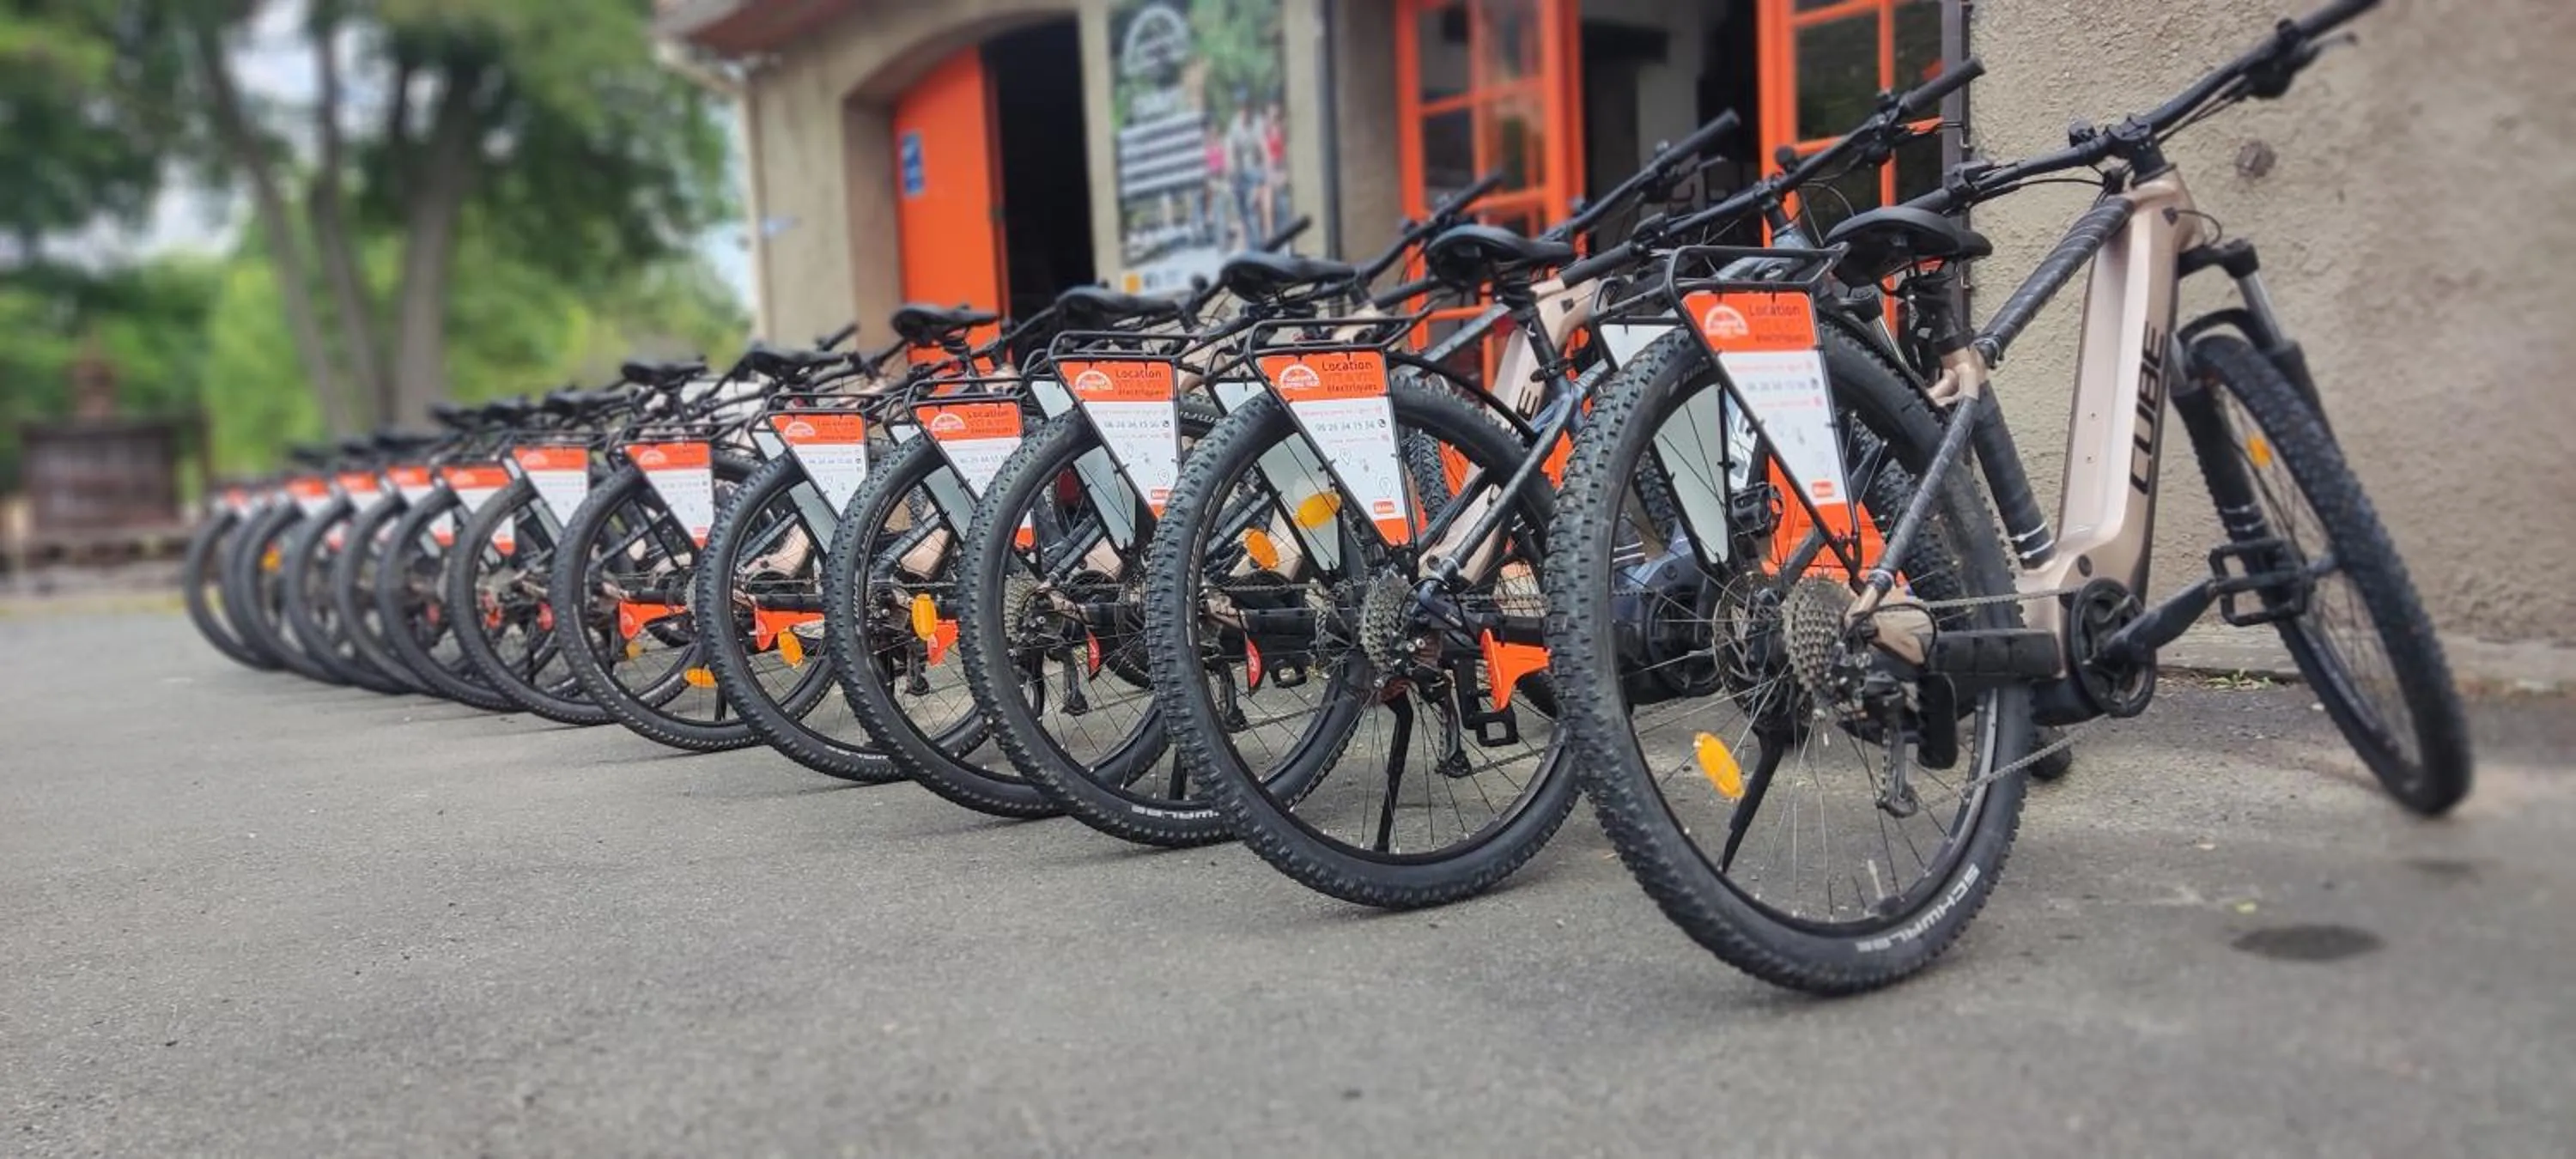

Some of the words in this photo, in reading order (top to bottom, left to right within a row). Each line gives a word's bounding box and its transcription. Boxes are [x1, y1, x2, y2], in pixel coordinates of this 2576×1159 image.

[1748, 304, 1801, 317] Location
[1321, 361, 1373, 372] Location
[1115, 368, 1162, 379] Location
[2130, 320, 2165, 495] CUBE
